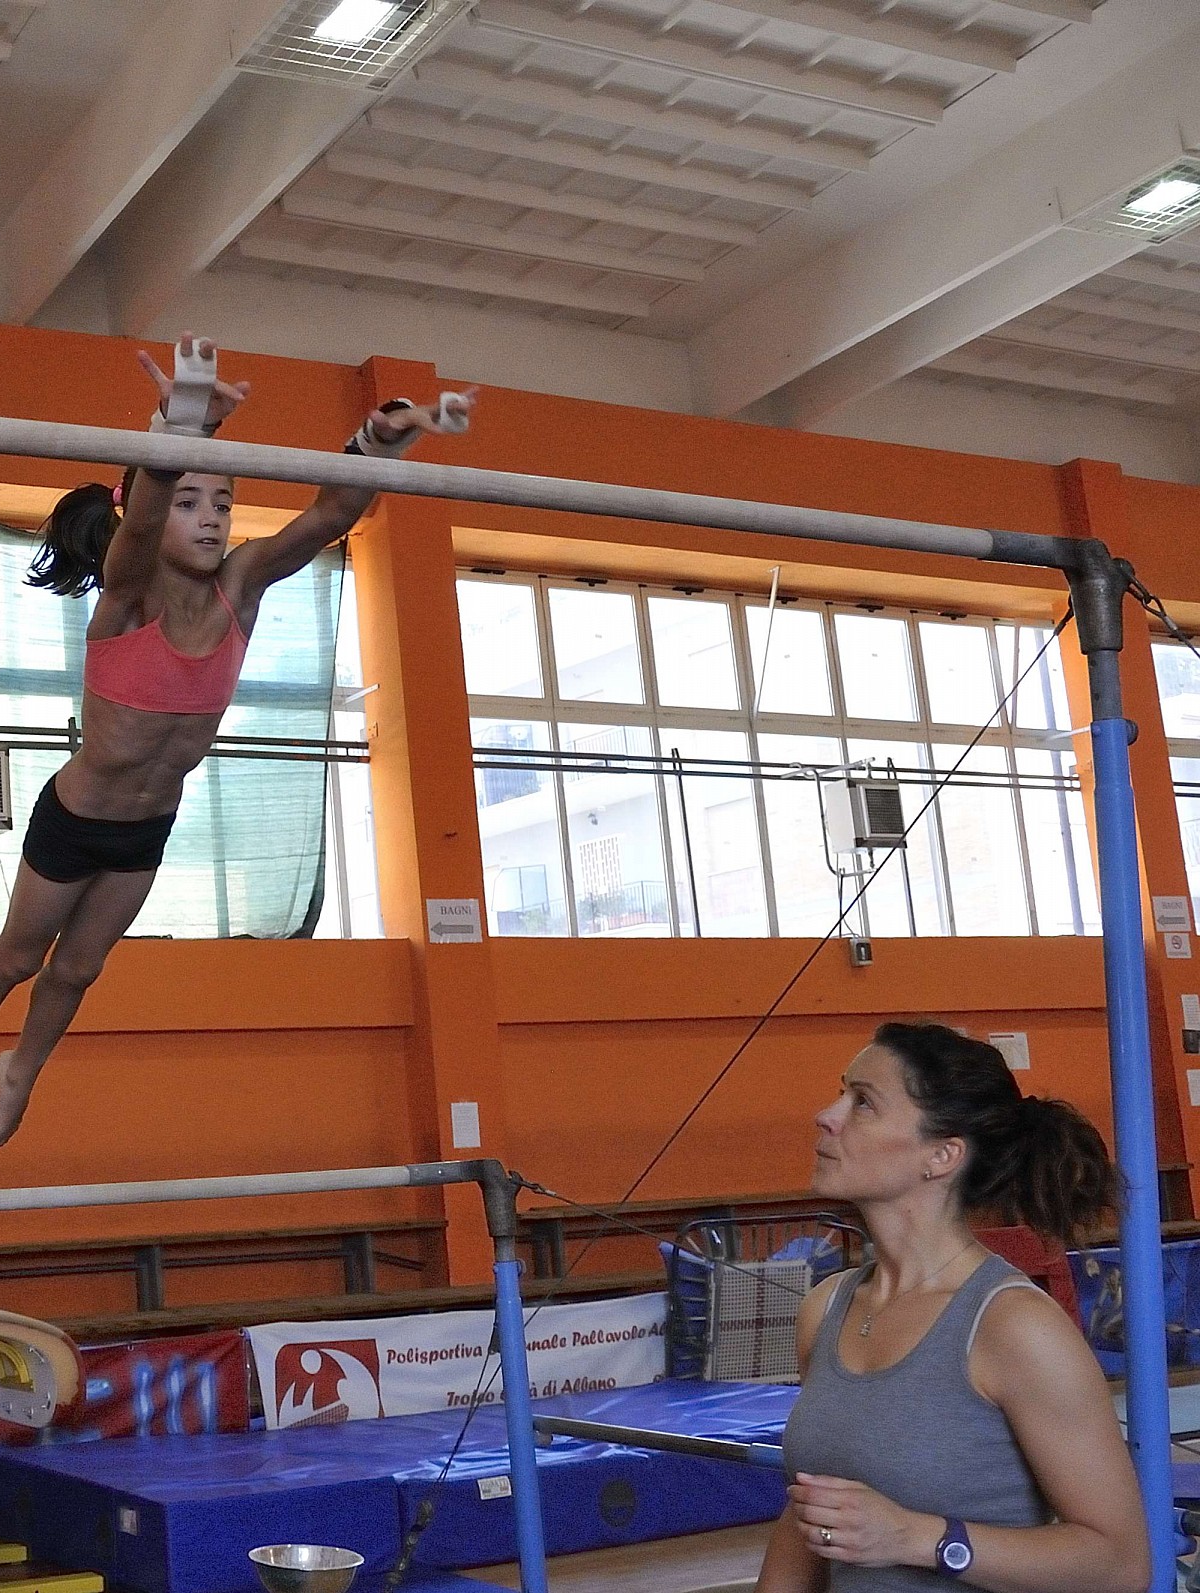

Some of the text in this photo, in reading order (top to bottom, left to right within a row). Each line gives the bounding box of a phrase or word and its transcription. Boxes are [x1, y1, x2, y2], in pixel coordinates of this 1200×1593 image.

[440, 905, 472, 915] BAGNI
[387, 1344, 482, 1365] Polisportiva
[572, 1325, 646, 1346] Pallavolo
[543, 1380, 557, 1396] di
